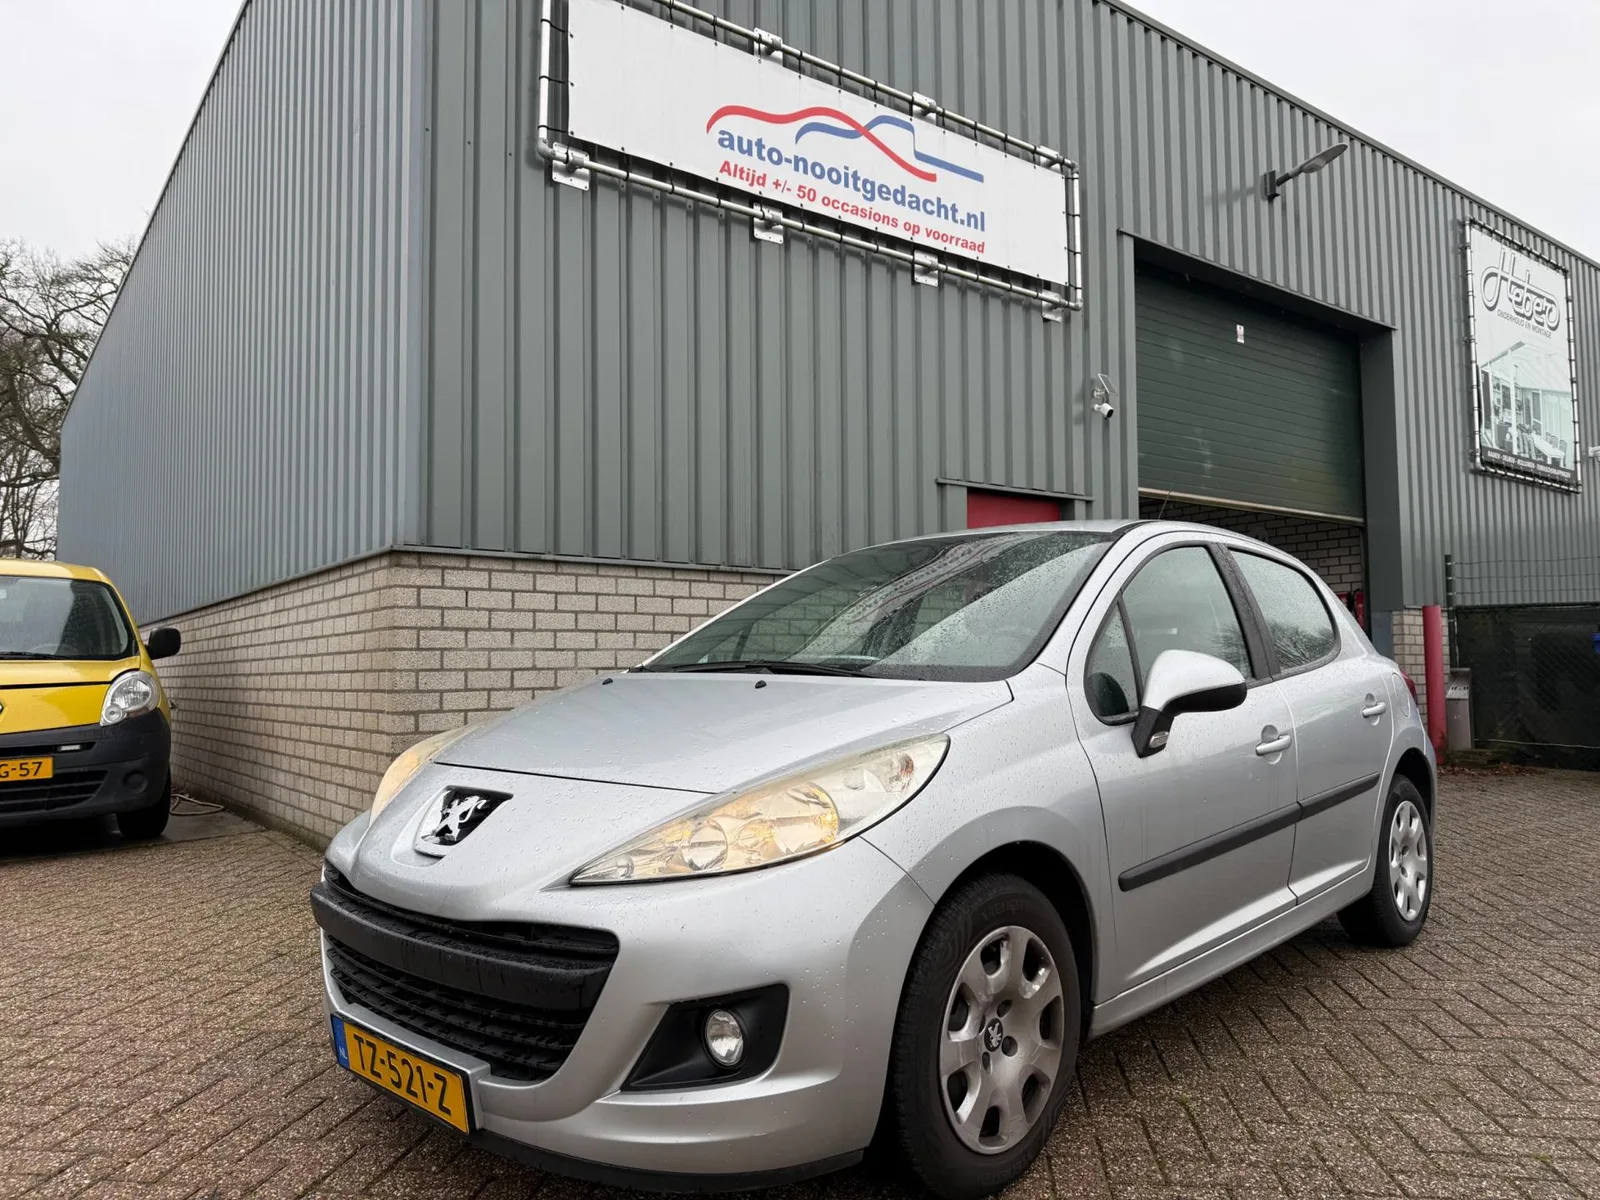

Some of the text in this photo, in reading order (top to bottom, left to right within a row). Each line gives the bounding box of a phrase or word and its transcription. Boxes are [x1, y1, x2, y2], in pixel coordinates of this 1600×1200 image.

[718, 129, 985, 232] auto-nooitgedacht.nl
[719, 160, 985, 254] Altijd +/- 50 occasions op voorraad
[1531, 324, 1552, 339] MONTAGE
[339, 1046, 348, 1060] NL
[353, 1033, 452, 1117] TZ-521-Z
